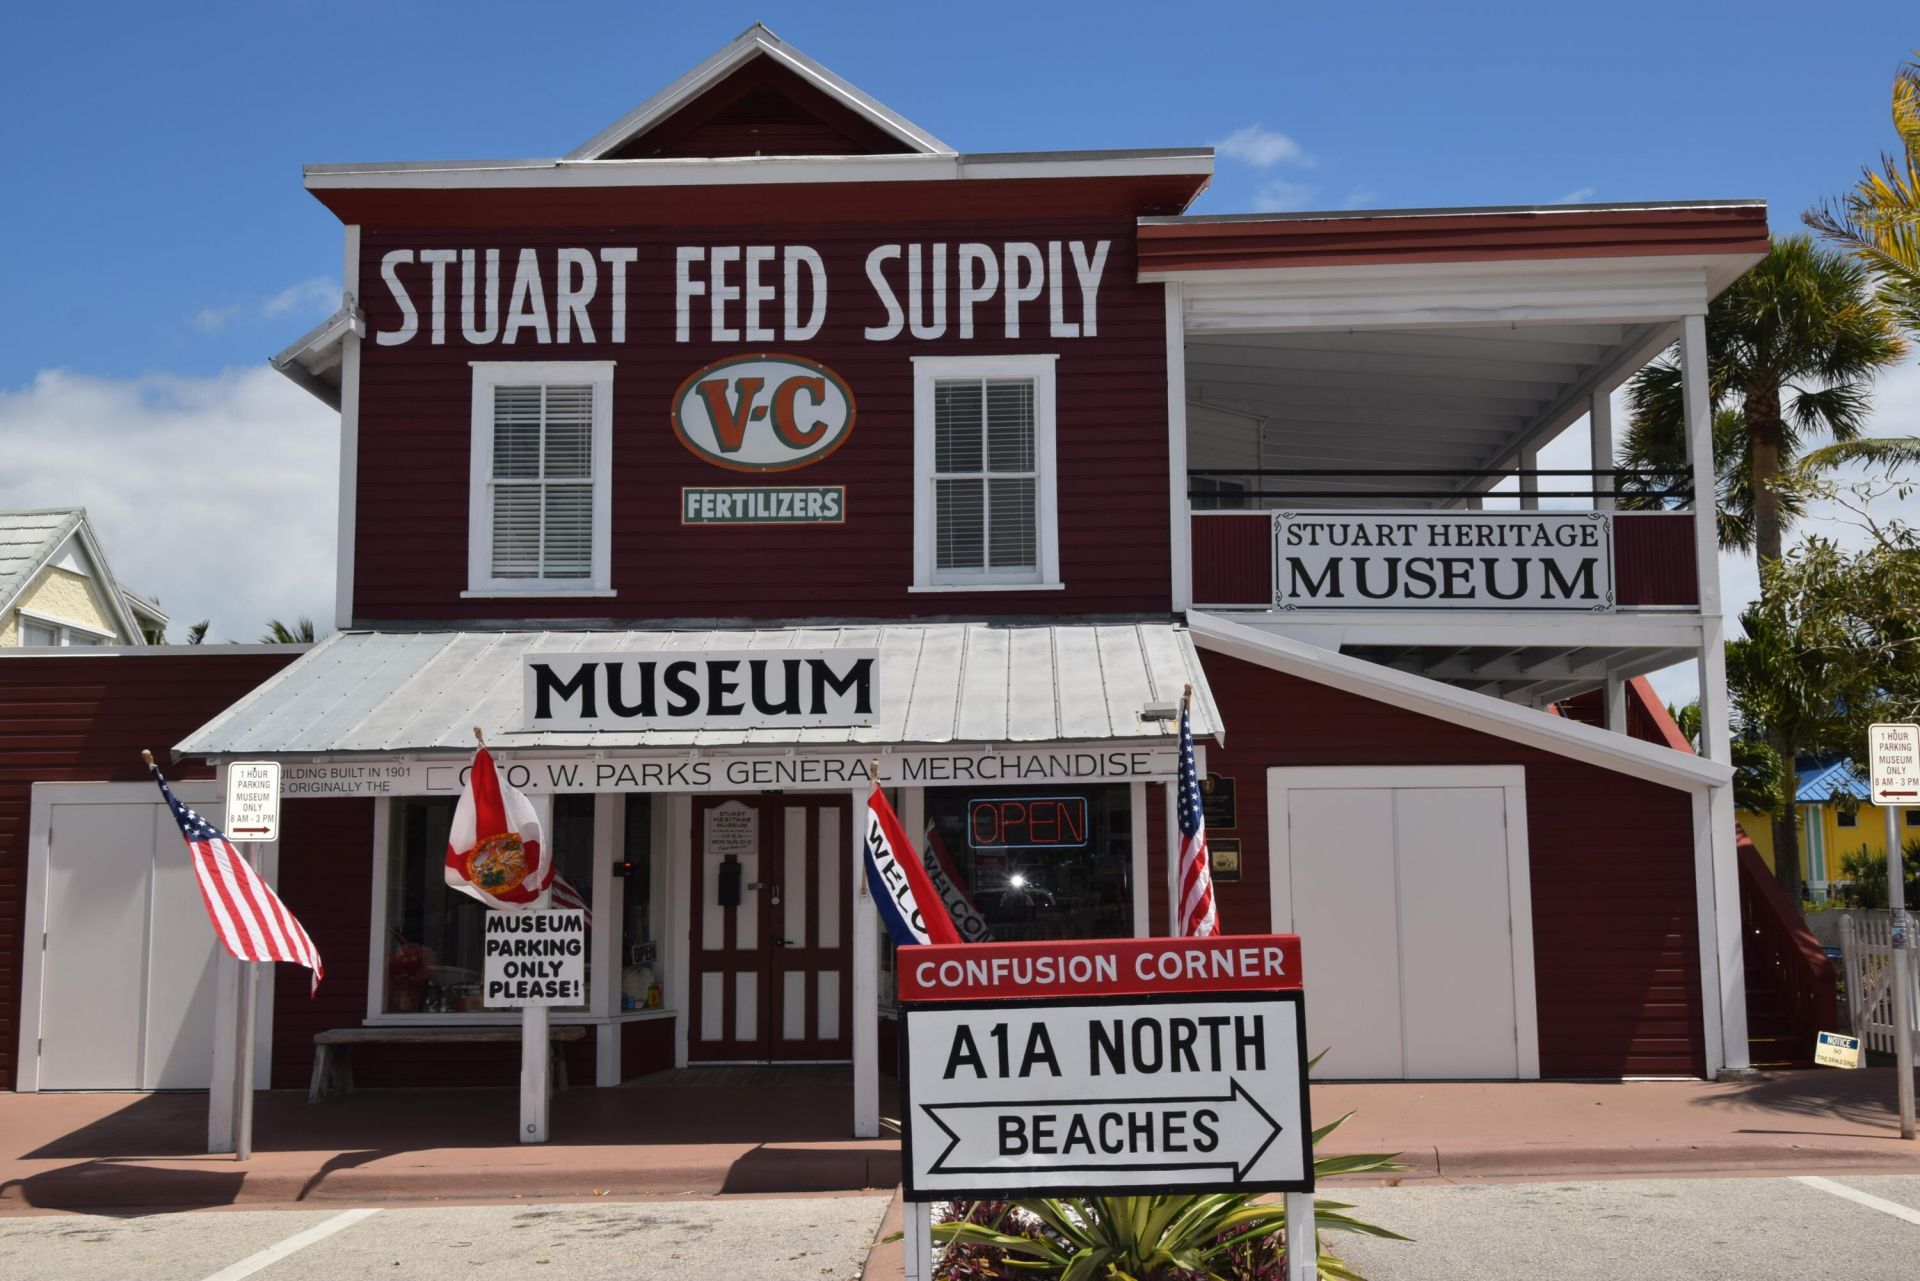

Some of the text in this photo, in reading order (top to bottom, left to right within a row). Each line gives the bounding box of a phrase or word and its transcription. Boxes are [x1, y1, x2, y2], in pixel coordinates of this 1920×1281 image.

[376, 240, 1111, 346] STUART FEED SUPPLY
[695, 375, 829, 453] V-C
[687, 492, 839, 518] FERTILIZERS
[1286, 523, 1599, 548] STUART HERITAGE
[1286, 557, 1600, 600] MUSEUM
[528, 658, 875, 719] MUSEUM
[1881, 732, 1909, 741] 1 HOUR
[1879, 743, 1912, 752] PARKING
[1879, 756, 1913, 764] MUSEUM
[241, 770, 268, 778] 1 HOUR
[280, 767, 411, 779] UILDING BUILT IN 1901
[547, 764, 583, 787] W.
[597, 762, 711, 786] PARKS
[902, 752, 1151, 780] MERCHANDISE
[1886, 767, 1907, 775] ONLY
[238, 780, 271, 789] PARKING
[288, 782, 362, 793] ORIGINALLY
[367, 781, 390, 792] THE
[1875, 778, 1880, 786] 8
[1881, 778, 1894, 786] AM
[1900, 778, 1906, 786] 3
[1907, 778, 1920, 786] PM
[236, 793, 270, 801] MUSEUM
[243, 803, 263, 812] ONLY
[230, 814, 235, 823] 8
[236, 814, 249, 823] AM
[255, 814, 261, 823] 3
[262, 814, 275, 823] PM
[973, 802, 1085, 845] OPEN
[487, 915, 582, 933] MUSEUM
[487, 939, 581, 957] PARKING
[503, 961, 563, 978] ONLY
[915, 946, 1285, 988] CONFUSION CORNER
[489, 980, 579, 998] PLEASE!
[942, 1014, 1266, 1080] A1A NORTH
[1827, 1035, 1851, 1048] NOTICE
[1817, 1054, 1856, 1068] TRESPASSING
[998, 1108, 1219, 1155] BEACHES
